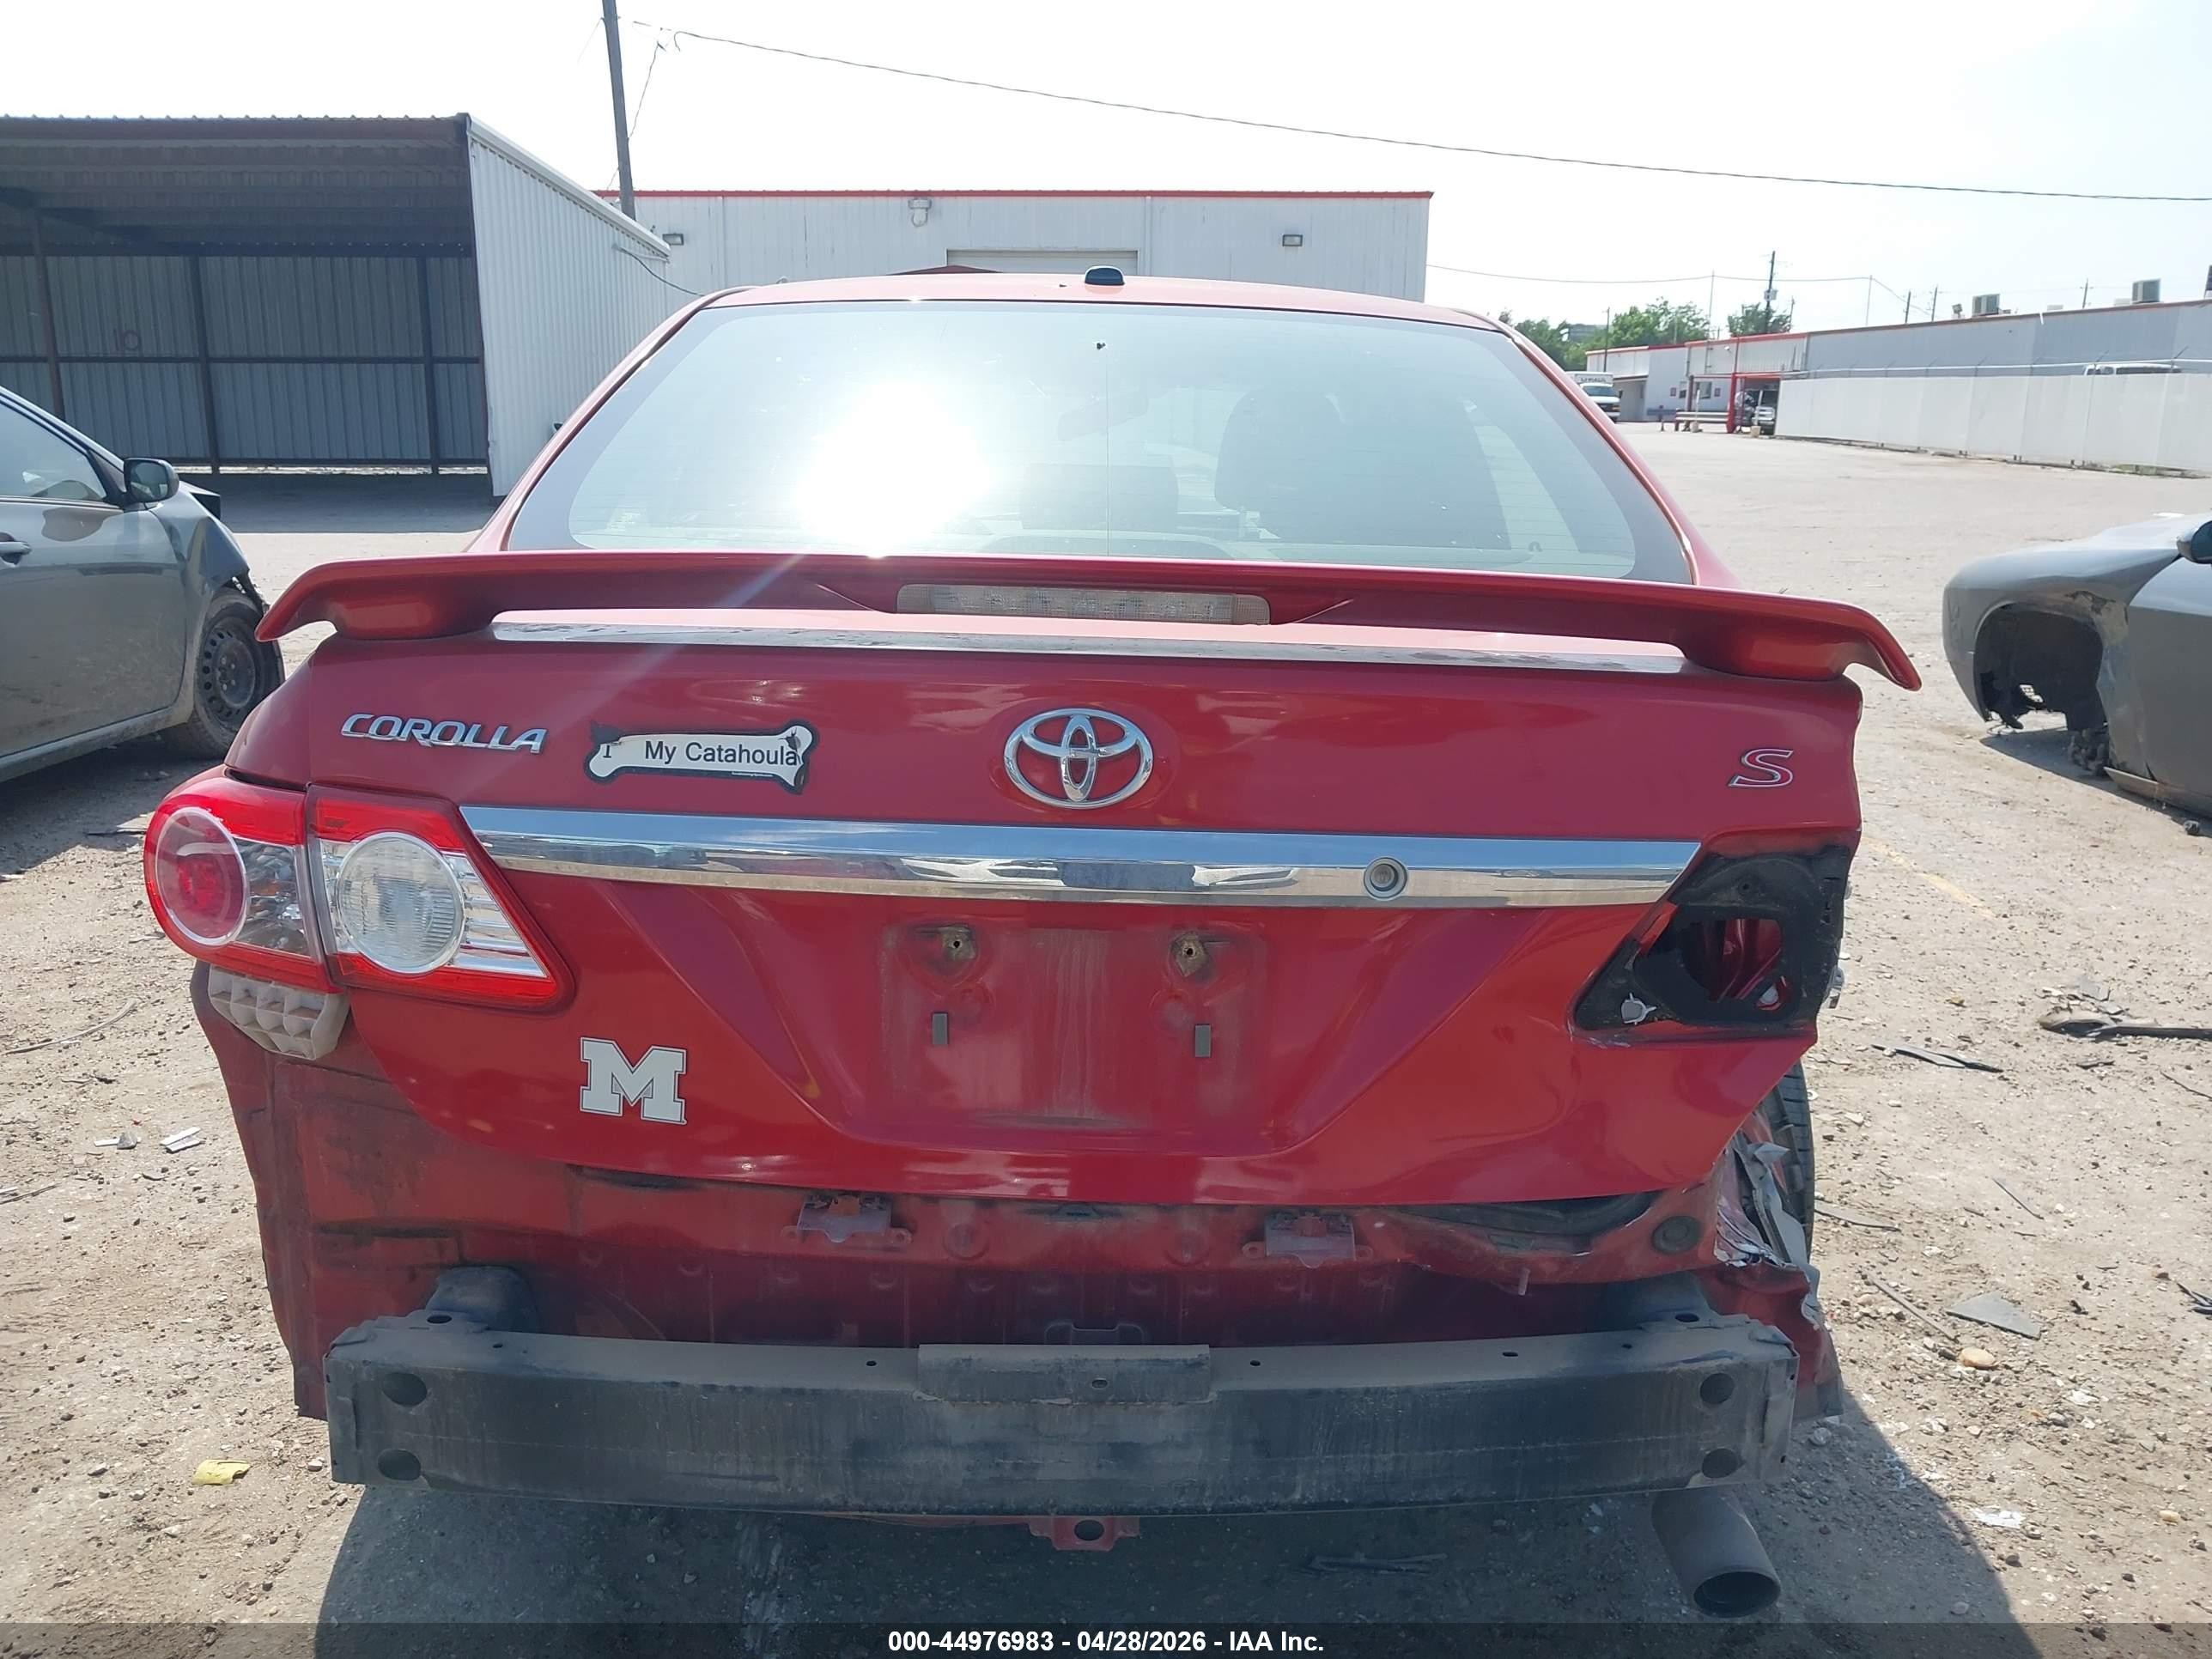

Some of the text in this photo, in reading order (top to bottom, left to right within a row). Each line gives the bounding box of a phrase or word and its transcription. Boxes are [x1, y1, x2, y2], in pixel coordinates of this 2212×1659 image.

[341, 714, 548, 754] COROLLA
[645, 740, 677, 764] My
[685, 742, 798, 766] Catahoula
[1729, 748, 1794, 787] S
[580, 1036, 687, 1125] M
